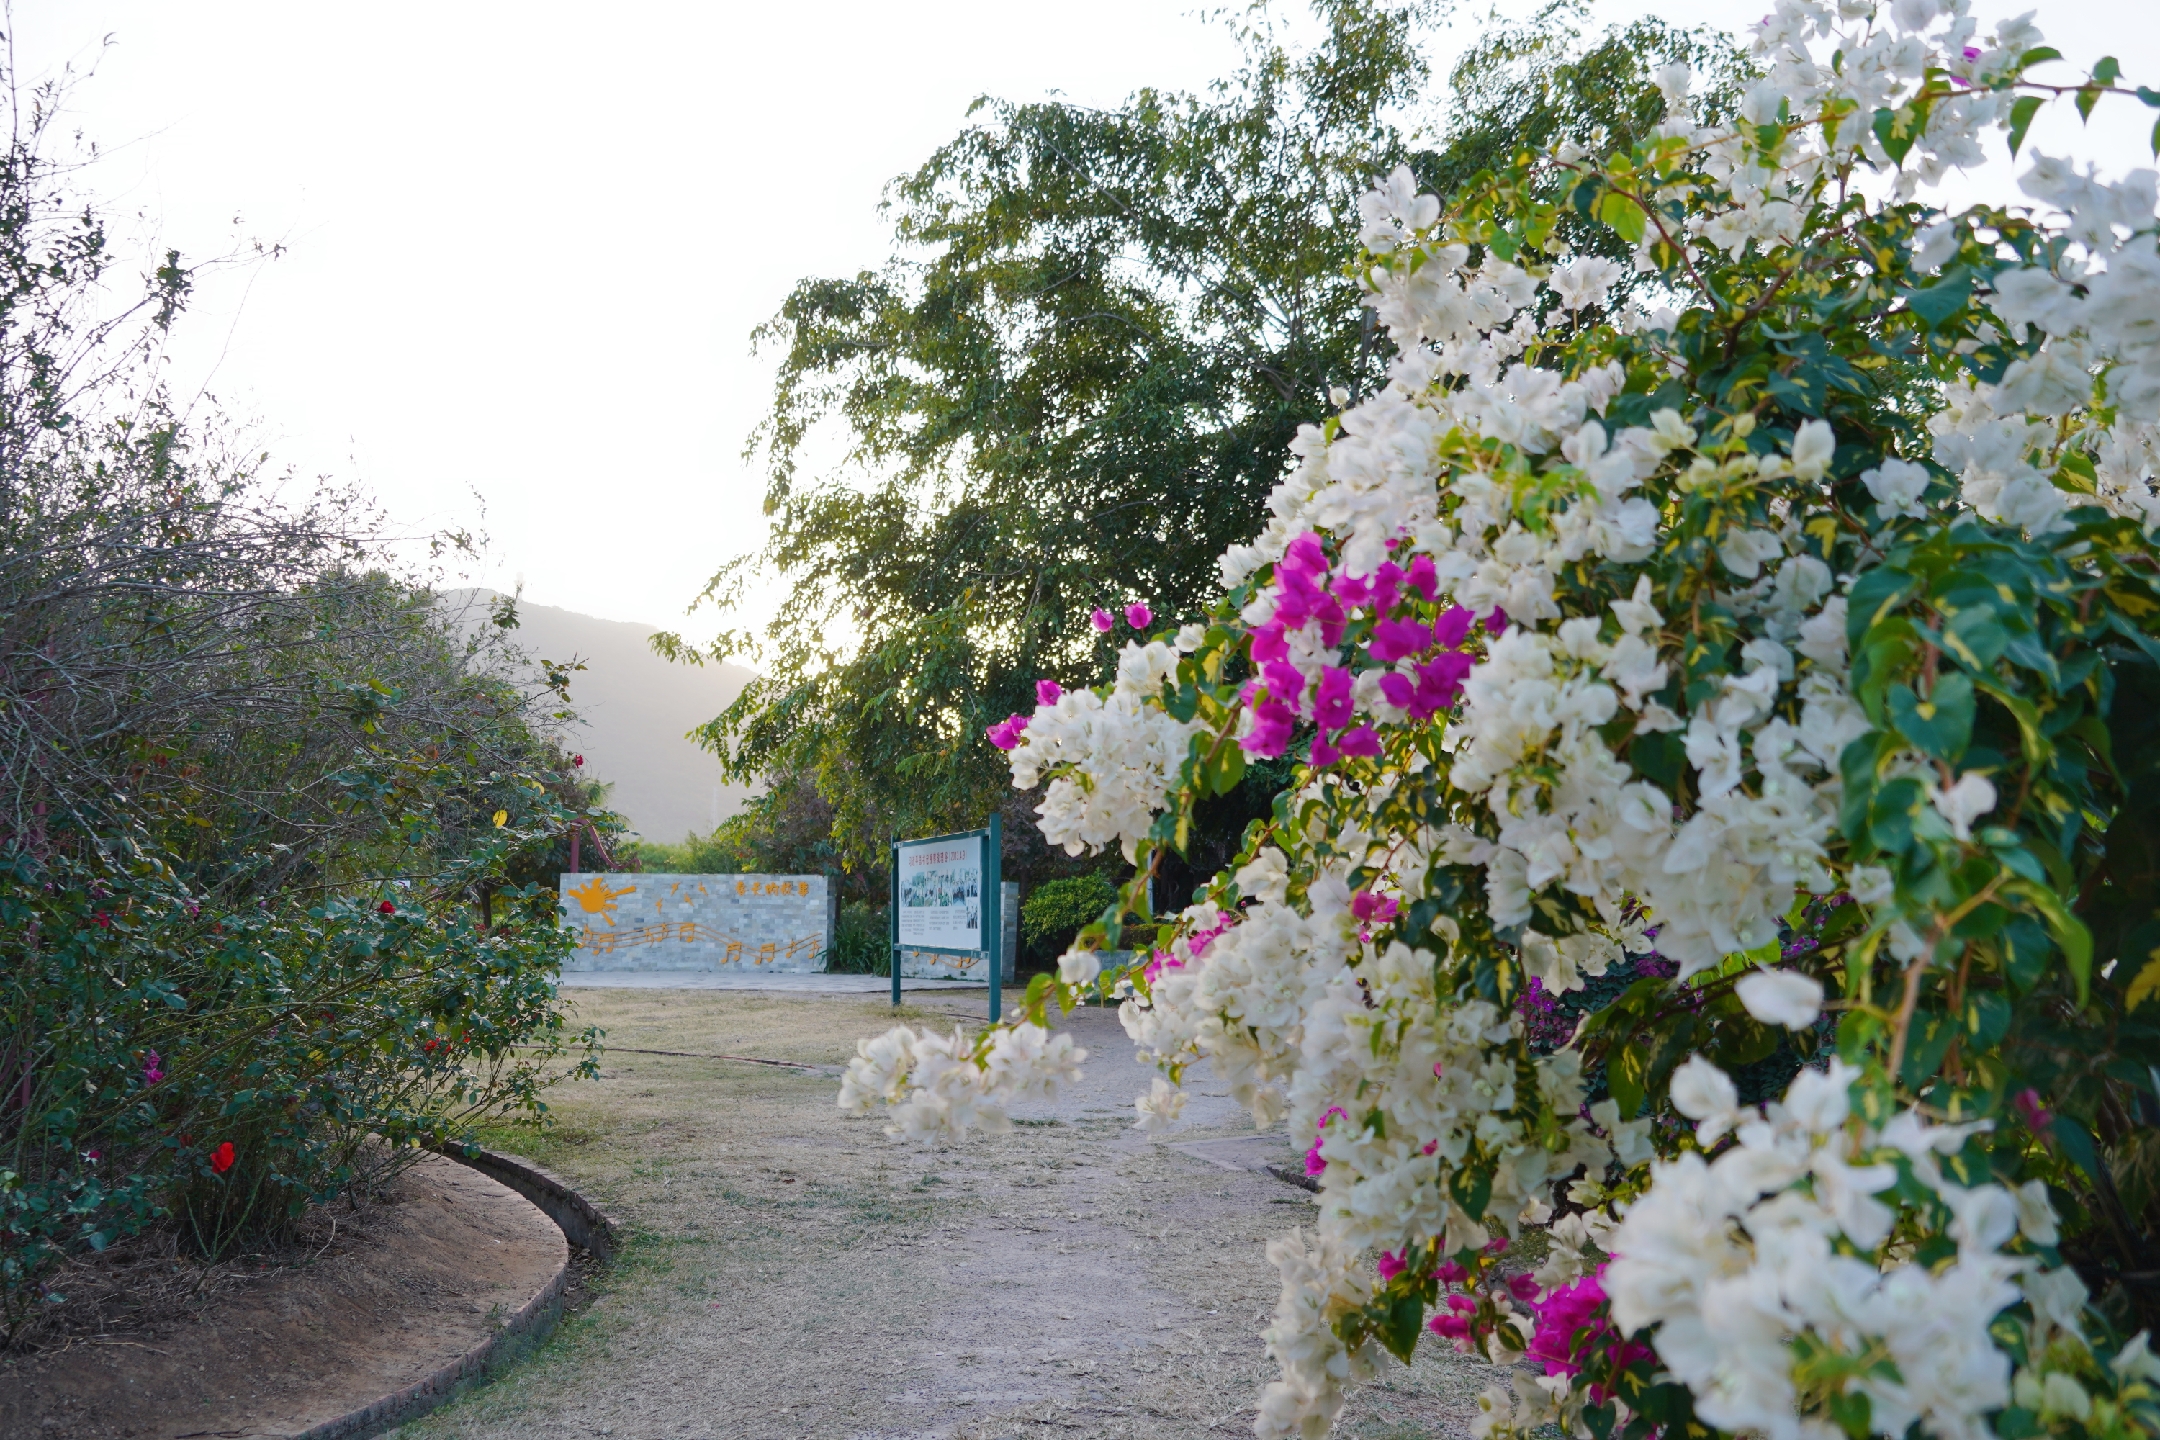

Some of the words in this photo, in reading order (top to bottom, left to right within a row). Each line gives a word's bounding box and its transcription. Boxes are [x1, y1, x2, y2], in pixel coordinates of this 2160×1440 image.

[735, 880, 810, 898] 春天的故事
